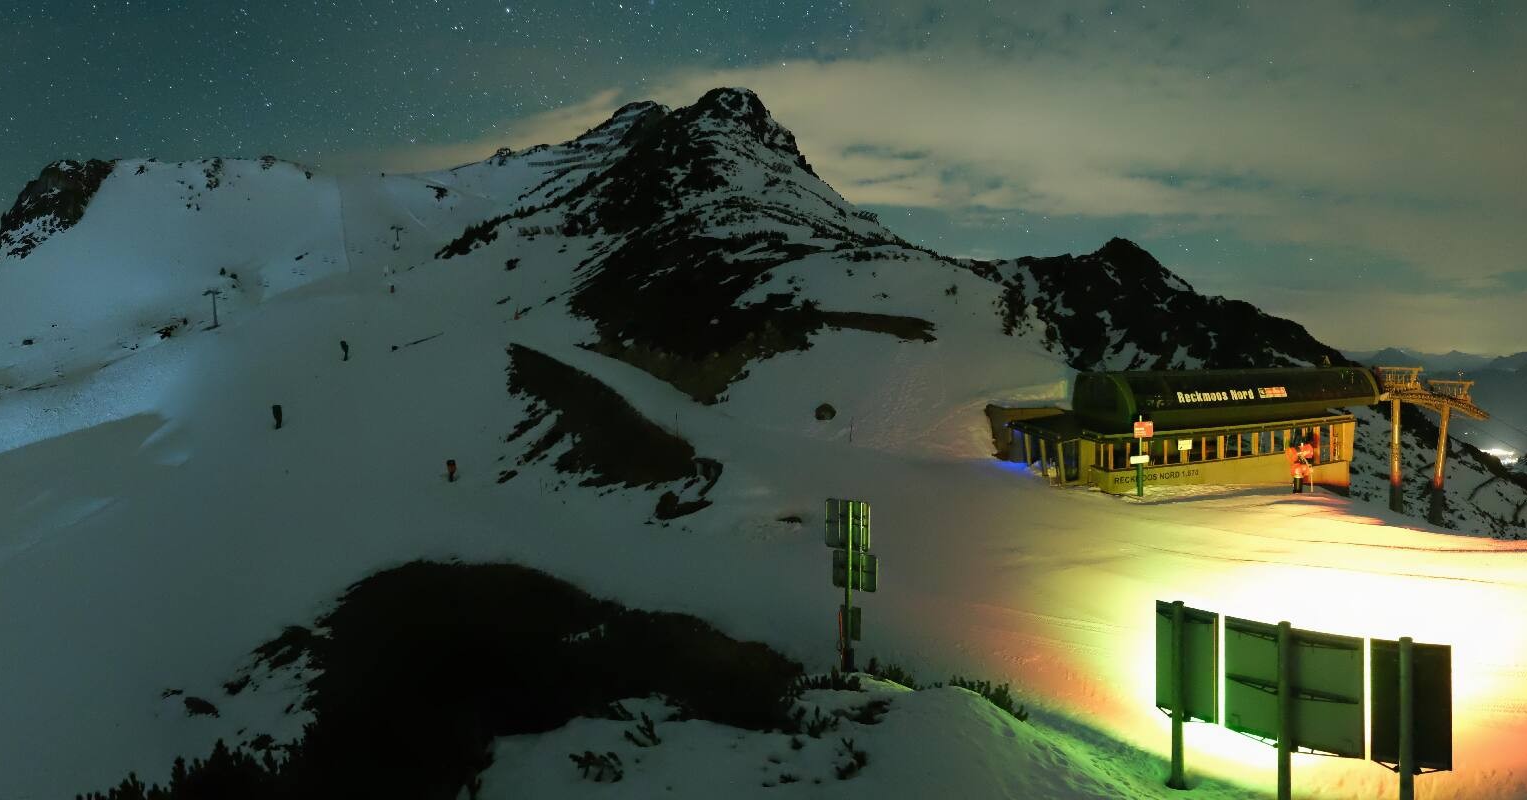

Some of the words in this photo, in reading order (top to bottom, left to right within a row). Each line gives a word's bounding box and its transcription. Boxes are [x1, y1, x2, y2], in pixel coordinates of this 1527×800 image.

[1177, 391, 1228, 403] Reckmoos
[1230, 389, 1254, 400] Nord
[1115, 474, 1157, 484] RECKOOS
[1160, 471, 1180, 480] NORD
